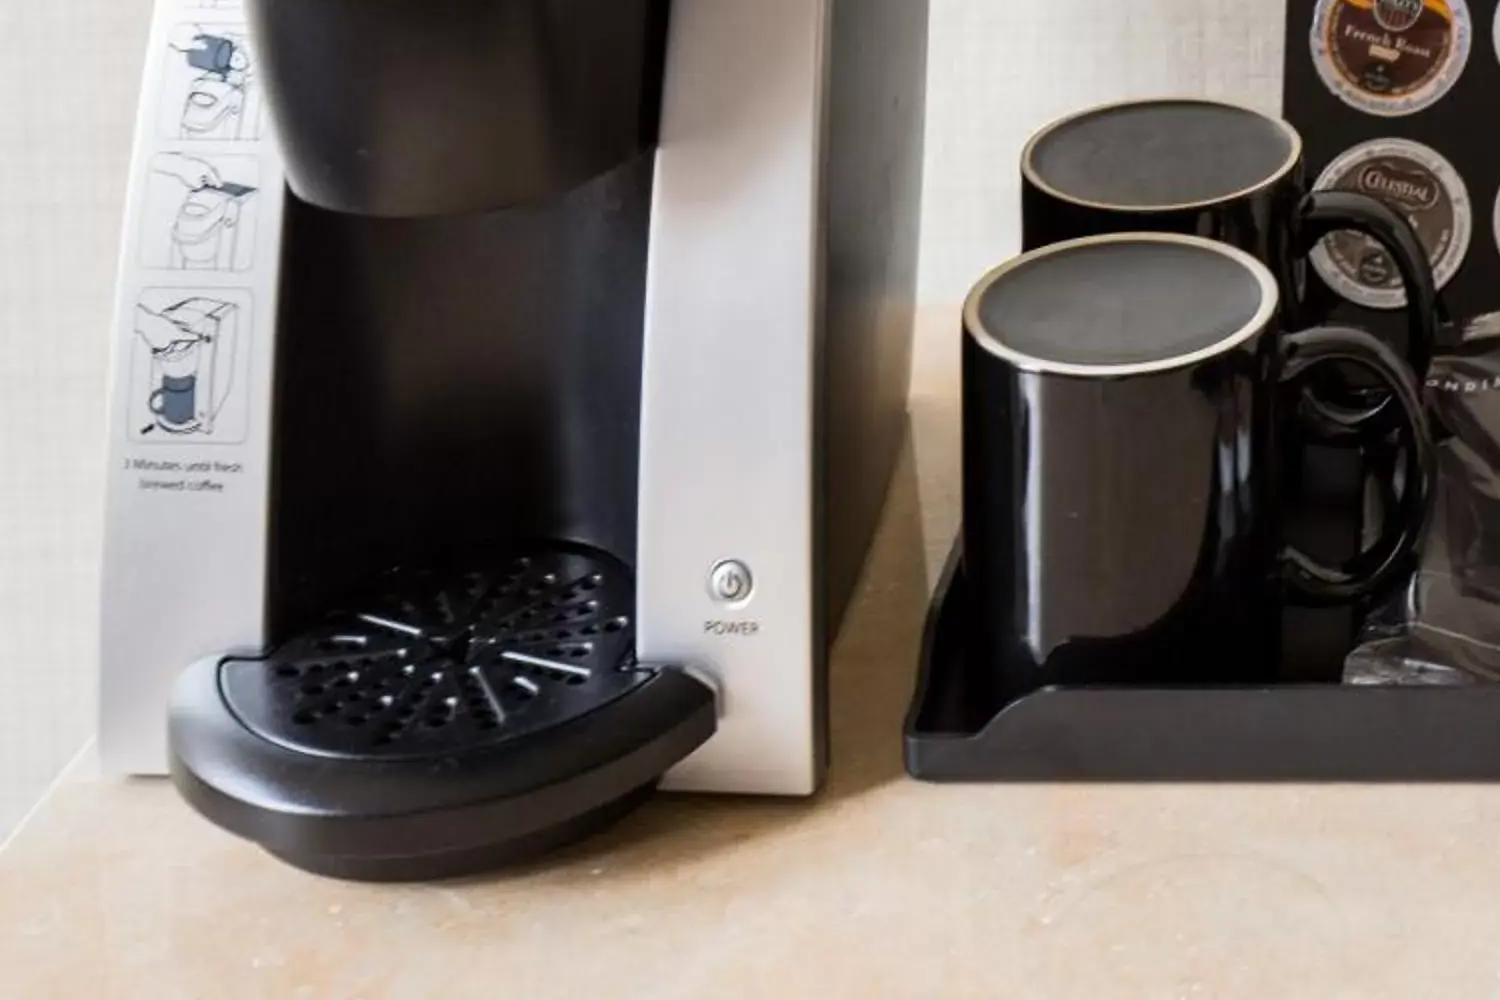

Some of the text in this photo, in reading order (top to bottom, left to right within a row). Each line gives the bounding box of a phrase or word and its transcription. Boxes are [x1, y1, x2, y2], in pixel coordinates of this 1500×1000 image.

[1344, 23, 1391, 48] French
[1395, 36, 1431, 58] Roast
[703, 619, 759, 636] POWER
